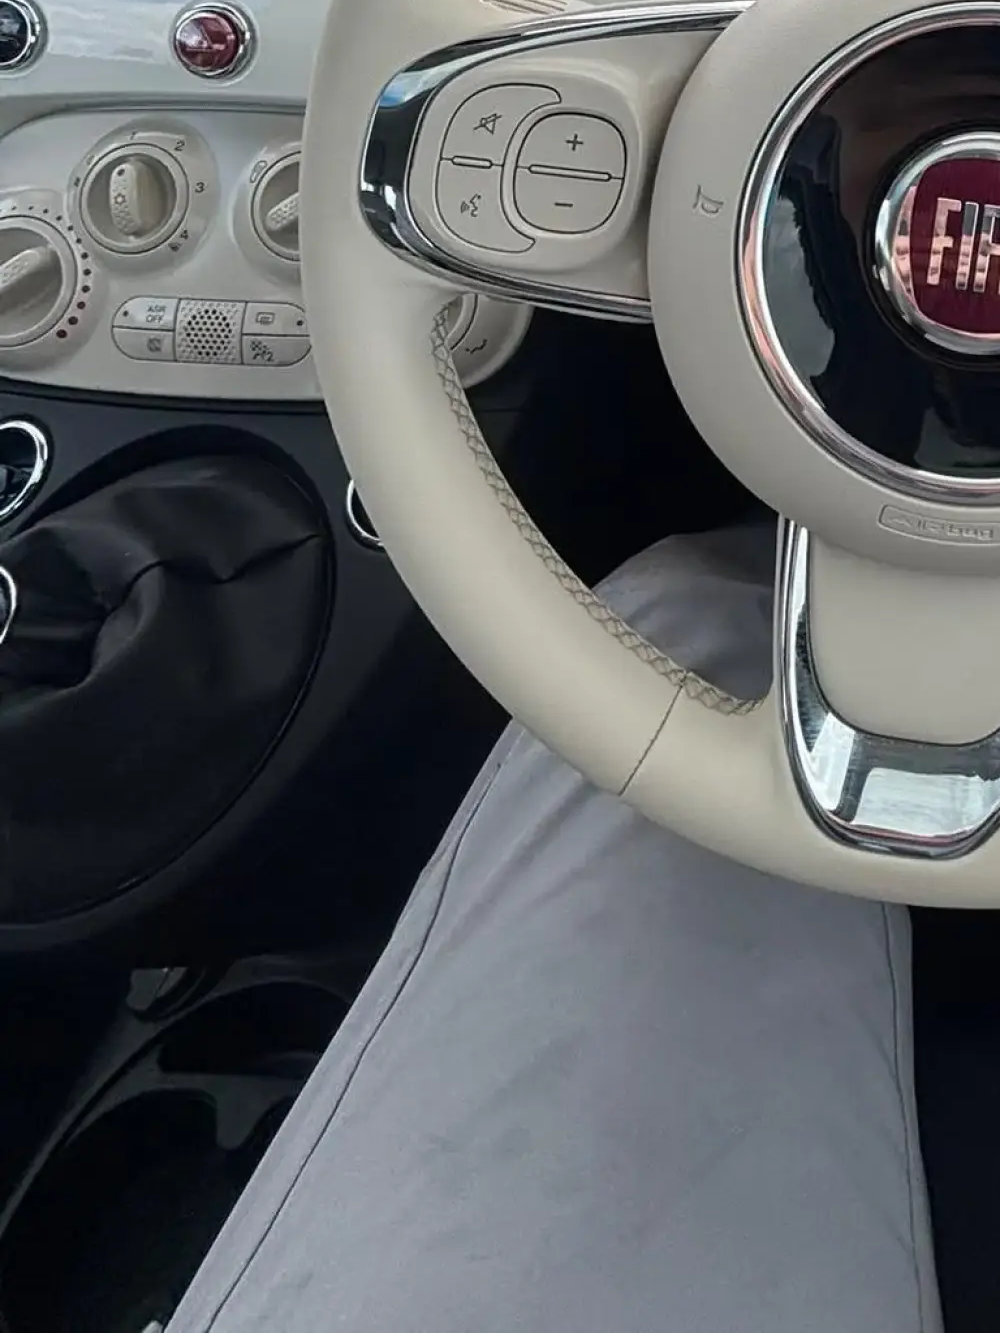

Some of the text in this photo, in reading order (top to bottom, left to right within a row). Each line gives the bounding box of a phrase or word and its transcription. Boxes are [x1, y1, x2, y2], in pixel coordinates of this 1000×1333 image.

[174, 139, 186, 152] 2
[195, 181, 206, 194] 3
[145, 313, 164, 324] OFF
